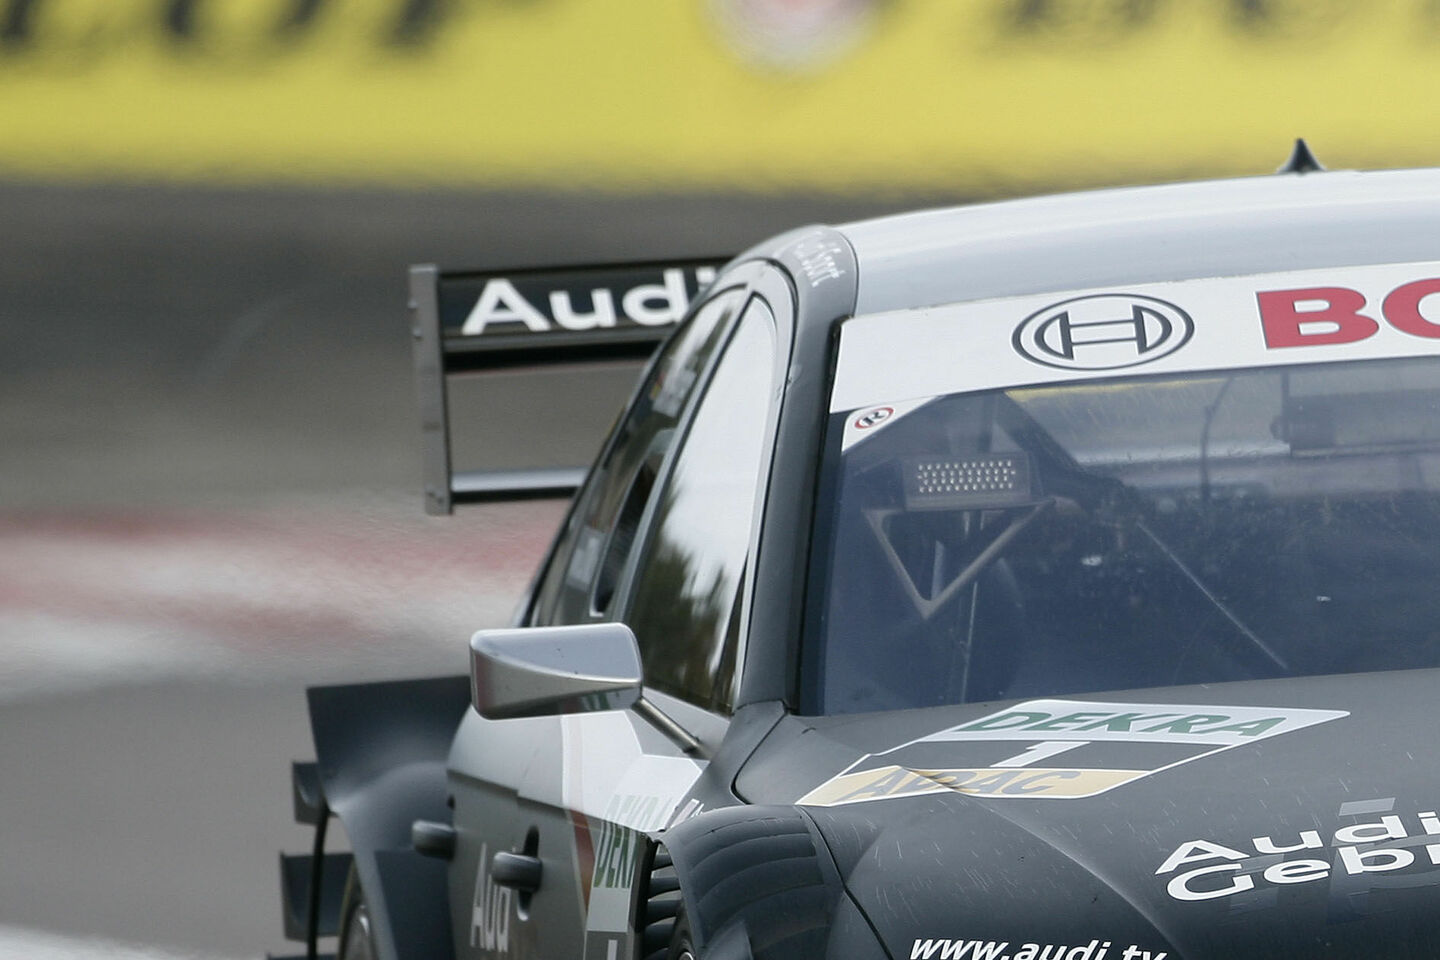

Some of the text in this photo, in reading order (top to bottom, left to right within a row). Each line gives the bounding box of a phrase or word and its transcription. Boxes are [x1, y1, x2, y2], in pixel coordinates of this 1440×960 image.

[958, 711, 1288, 737] DEKRA
[988, 741, 1092, 768] 1
[836, 770, 1083, 799] ADAC
